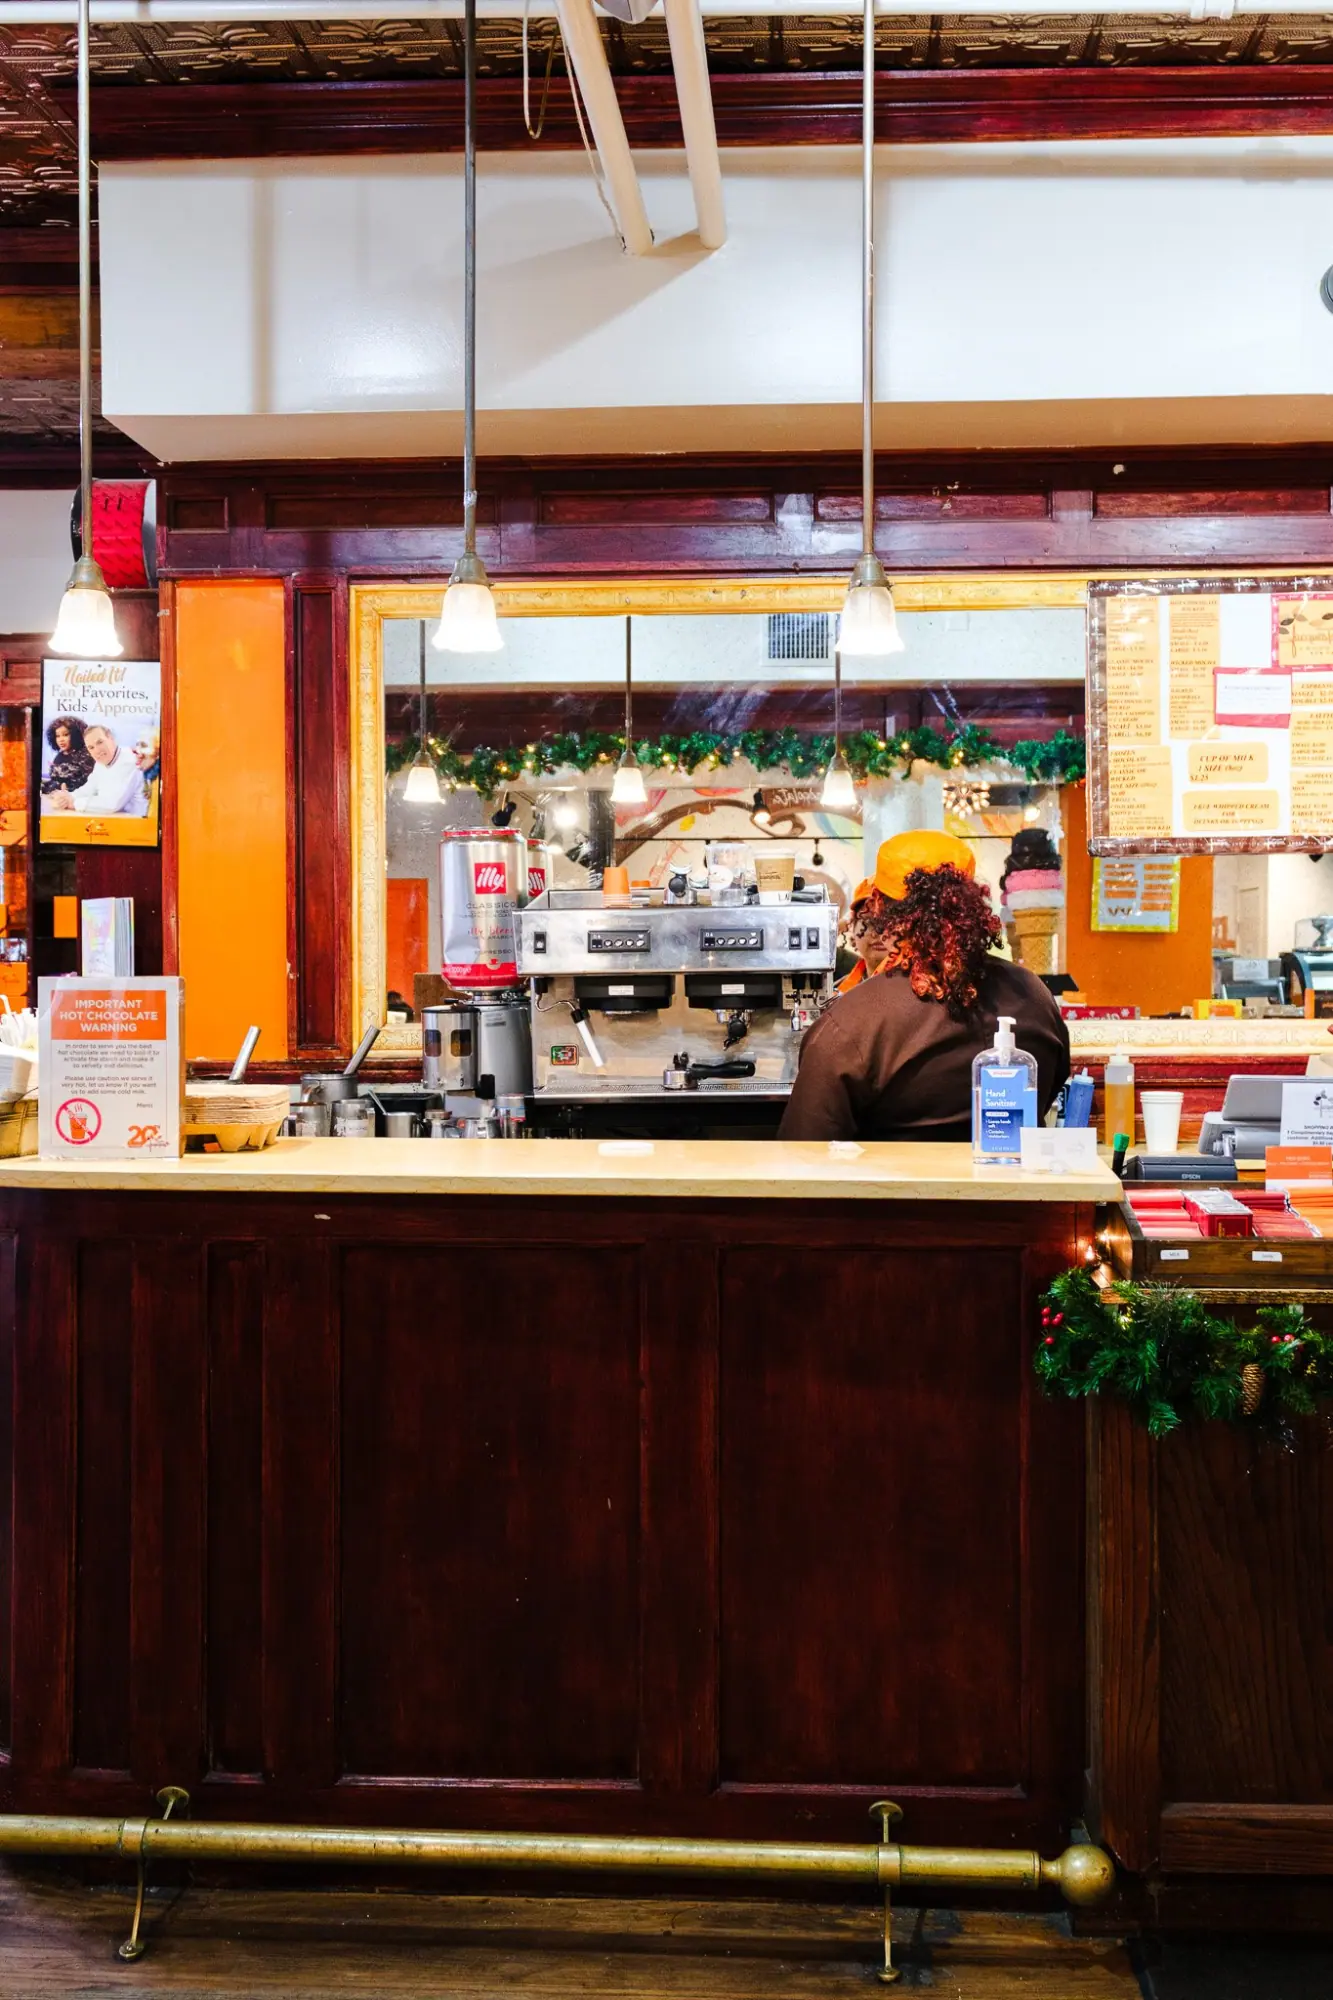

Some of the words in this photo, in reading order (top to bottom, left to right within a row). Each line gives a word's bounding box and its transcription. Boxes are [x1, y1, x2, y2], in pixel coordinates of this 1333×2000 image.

[64, 665, 105, 687] Nailed
[109, 666, 127, 685] It!
[51, 684, 76, 697] Fan
[82, 685, 149, 700] Favorites,
[57, 699, 88, 712] Kids
[92, 700, 157, 717] Approve!
[476, 866, 505, 893] illy
[466, 901, 516, 909] CLASSICO
[75, 1000, 143, 1009] IMPORTANT
[60, 1011, 83, 1020] HOT
[87, 1011, 158, 1021] CHOCOLATE
[80, 1023, 137, 1032] WARNING
[985, 1089, 1006, 1097] Hand
[985, 1099, 1016, 1107] Sanitizer
